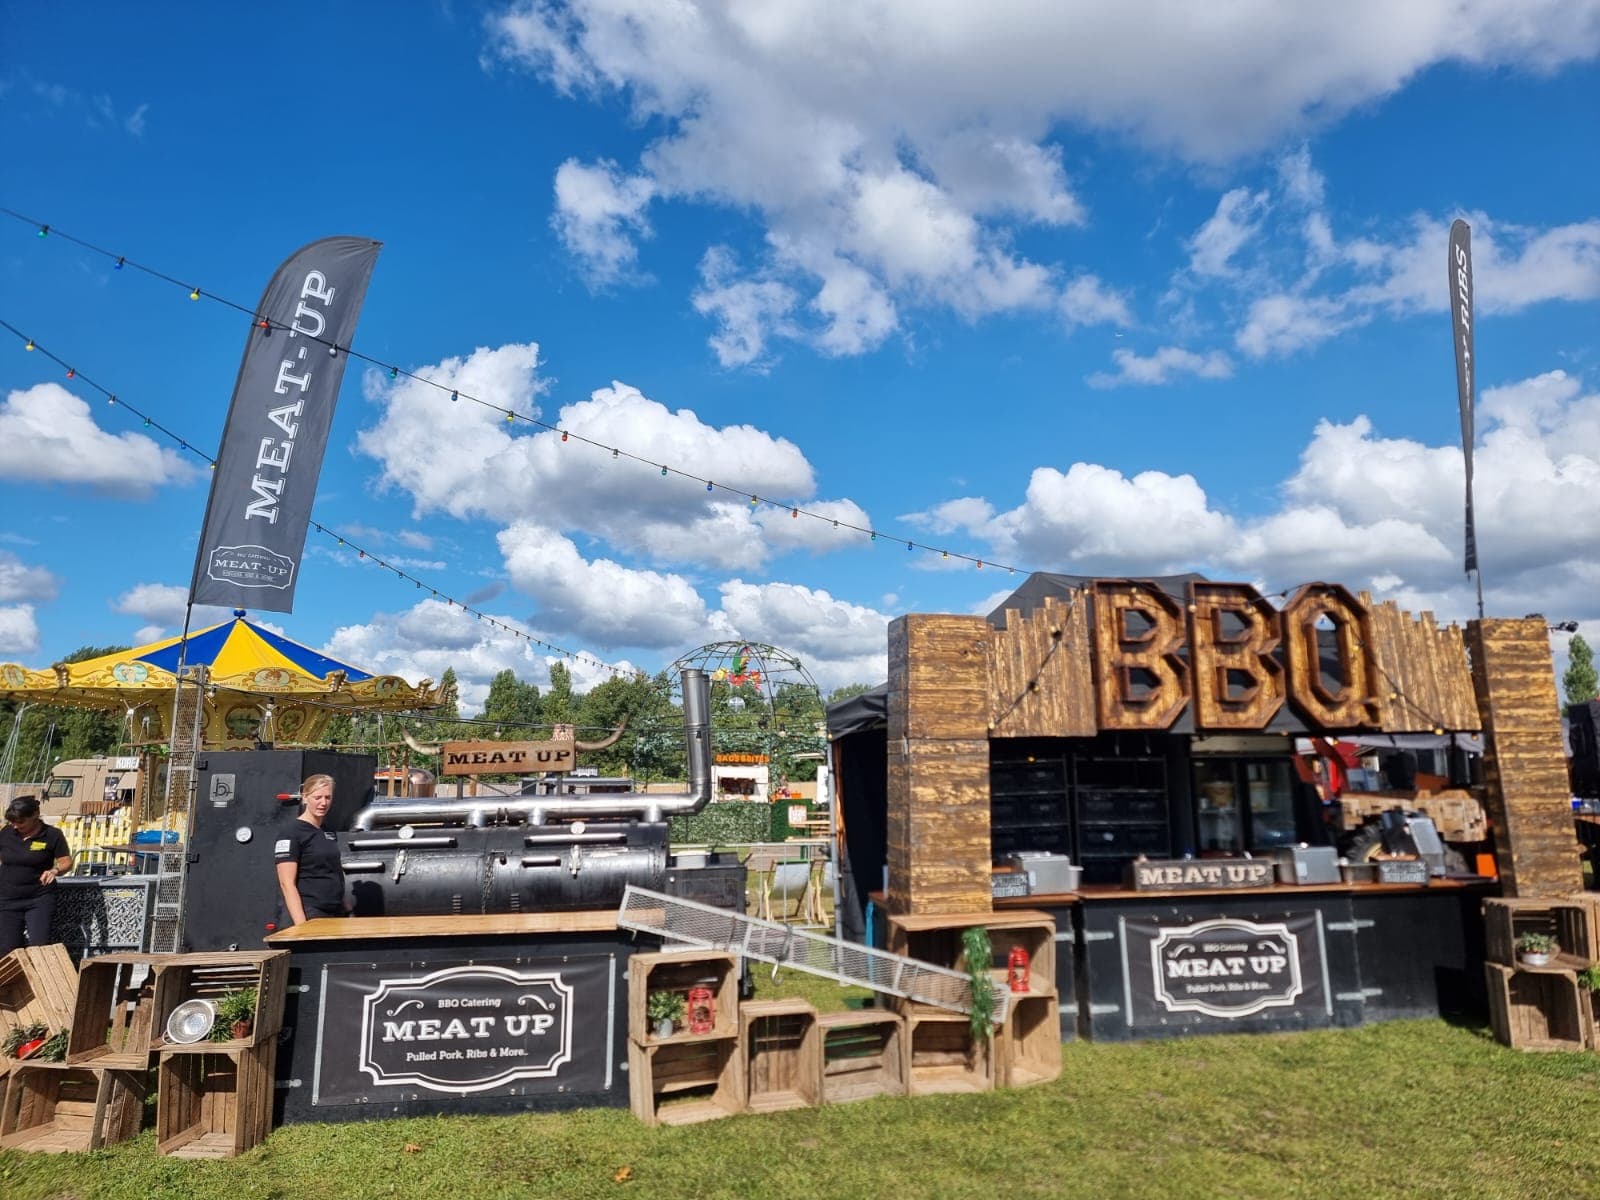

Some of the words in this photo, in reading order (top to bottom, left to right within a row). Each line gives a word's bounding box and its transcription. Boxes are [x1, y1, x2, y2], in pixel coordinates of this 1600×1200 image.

[245, 270, 335, 524] MEAT-UP
[214, 559, 288, 576] MEAT-UP
[1090, 579, 1381, 730] BBQ
[447, 751, 527, 765] MEAT
[535, 749, 570, 763] UP
[1140, 867, 1222, 885] MEAT
[1226, 864, 1266, 882] UP
[1166, 957, 1246, 978] MEAT
[1249, 955, 1287, 974] UP
[438, 999, 459, 1009] BBQ
[460, 997, 502, 1008] Catering
[382, 1017, 496, 1042] MEAT
[504, 1014, 554, 1036] UP
[406, 1051, 437, 1062] Pulled
[466, 1049, 488, 1059] Ribs
[489, 1048, 497, 1058] &
